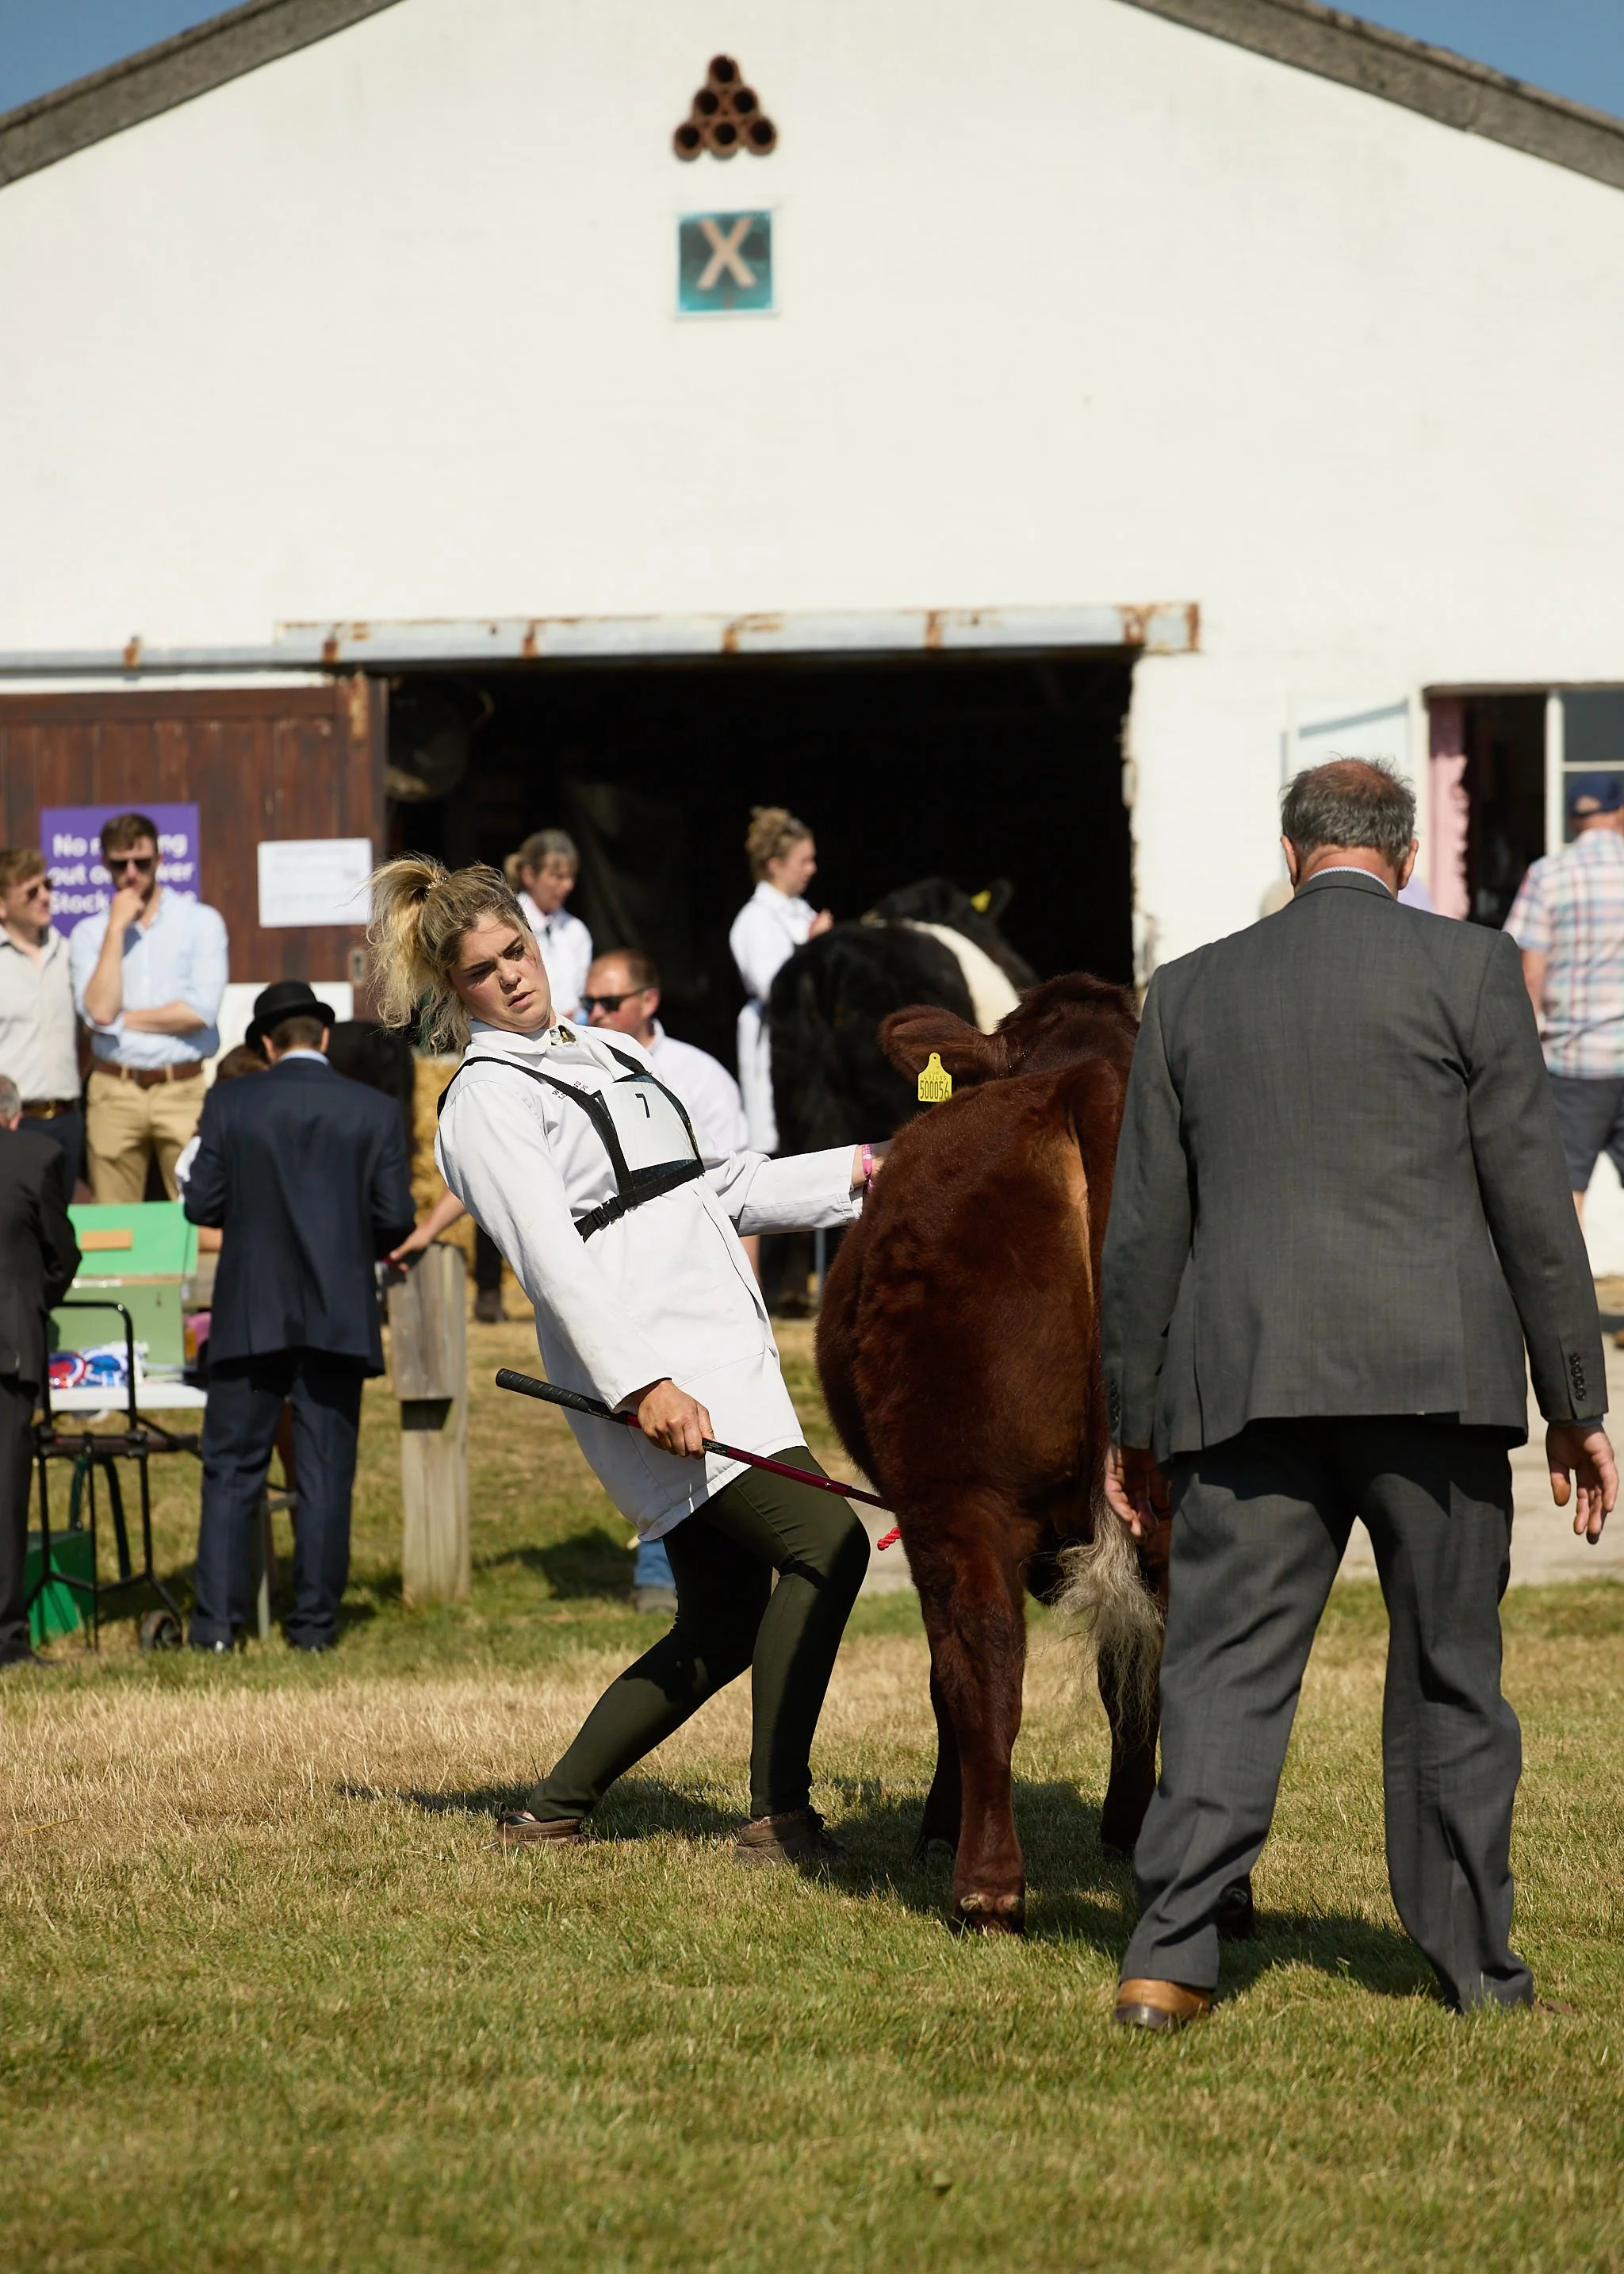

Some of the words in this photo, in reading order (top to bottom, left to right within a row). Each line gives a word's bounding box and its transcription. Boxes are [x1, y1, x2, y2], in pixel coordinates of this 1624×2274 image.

[695, 217, 757, 290] X
[52, 834, 88, 858] No
[48, 863, 88, 886] out
[920, 1080, 949, 1099] 500056
[634, 1094, 650, 1118] 7
